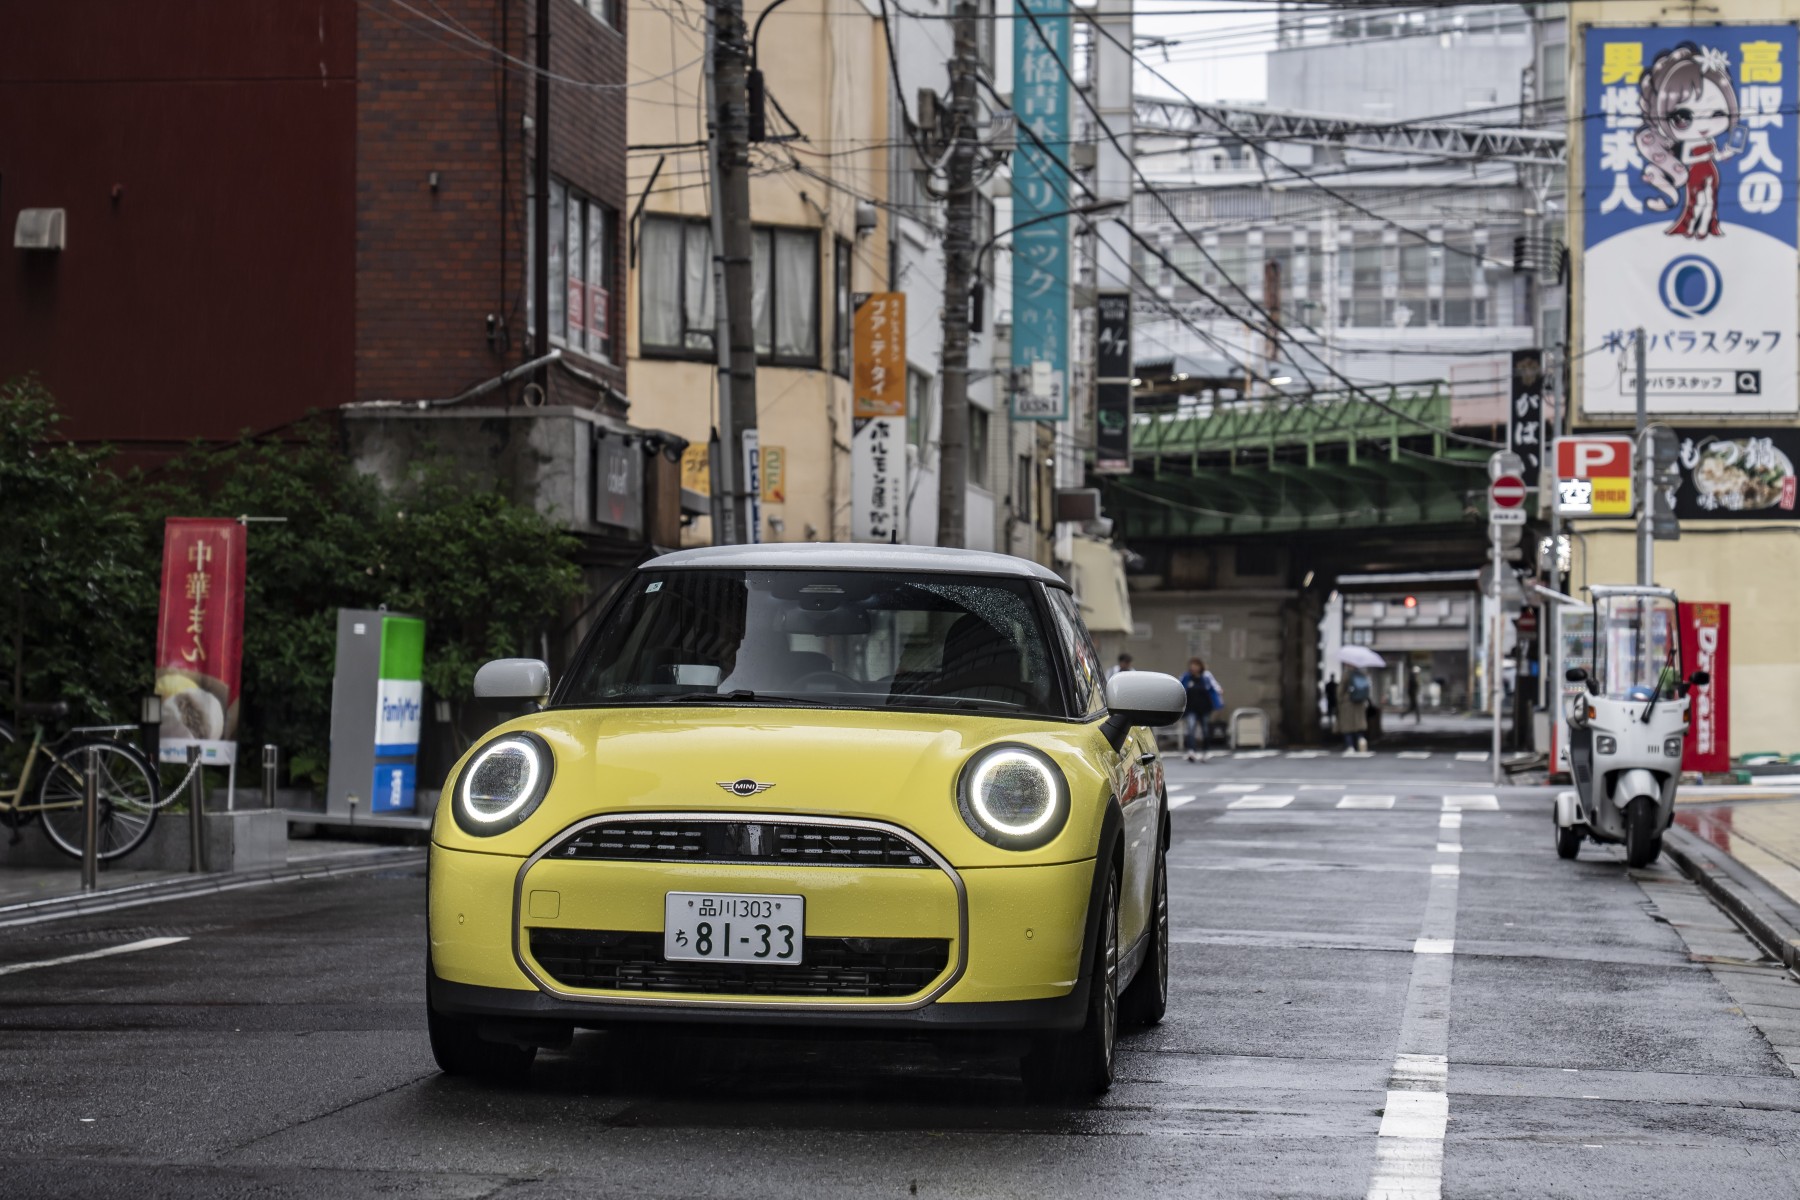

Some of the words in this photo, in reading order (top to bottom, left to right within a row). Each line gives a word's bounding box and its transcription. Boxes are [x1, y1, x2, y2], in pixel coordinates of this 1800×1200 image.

[1601, 42, 1643, 215] 男性求人
[1739, 41, 1783, 214] 高収入の
[1575, 442, 1616, 478] P
[1680, 437, 1775, 470] もつ鍋
[1558, 478, 1592, 512] 空
[181, 539, 212, 662] 中華まん
[383, 696, 419, 728] FamilyMart
[675, 929, 688, 947] ち
[695, 921, 795, 959] 81-33
